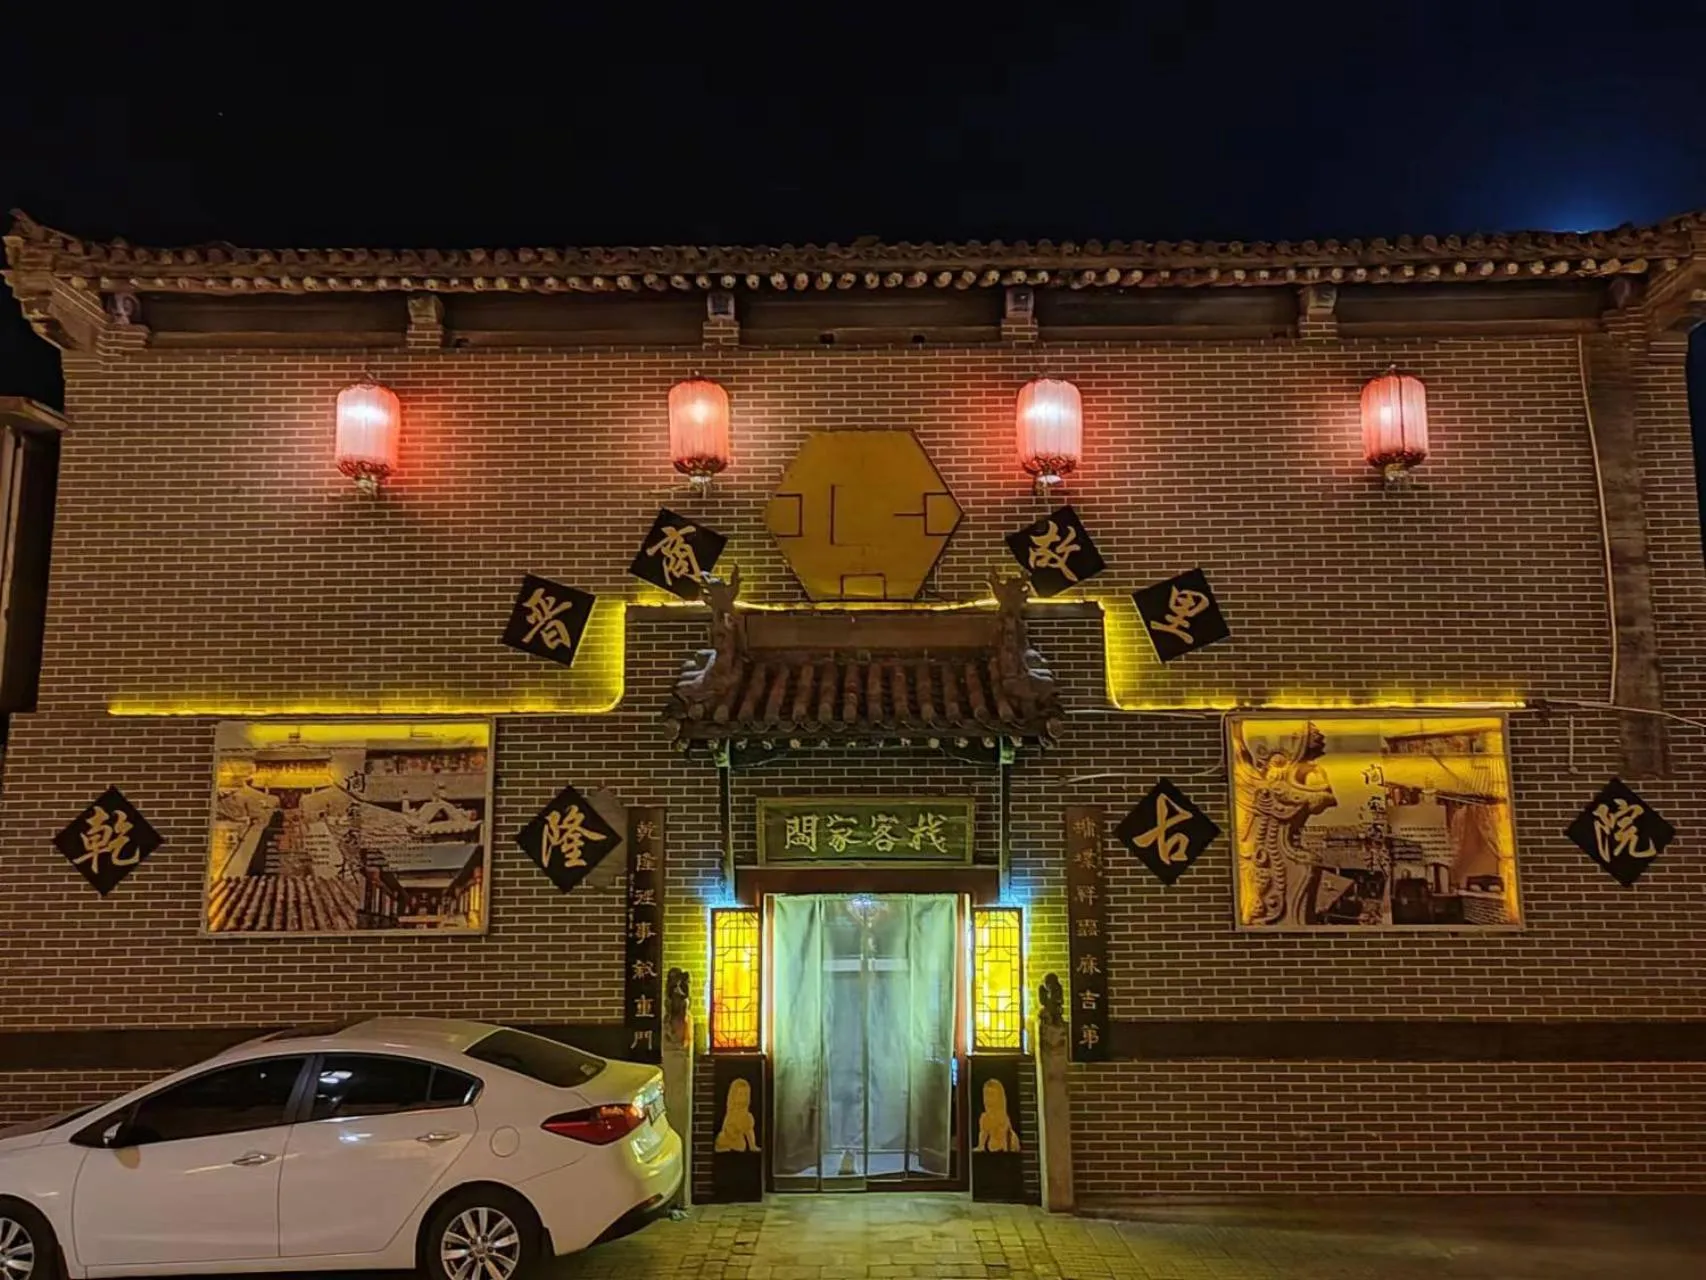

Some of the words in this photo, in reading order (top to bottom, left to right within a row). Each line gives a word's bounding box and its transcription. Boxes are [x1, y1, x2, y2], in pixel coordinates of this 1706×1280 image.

[646, 525, 703, 586] 商
[1029, 520, 1081, 582] 故
[1151, 585, 1210, 644] 里
[73, 806, 141, 873] 乾
[541, 810, 607, 869] 隆
[1133, 793, 1193, 865] 古
[1594, 800, 1659, 862] 院
